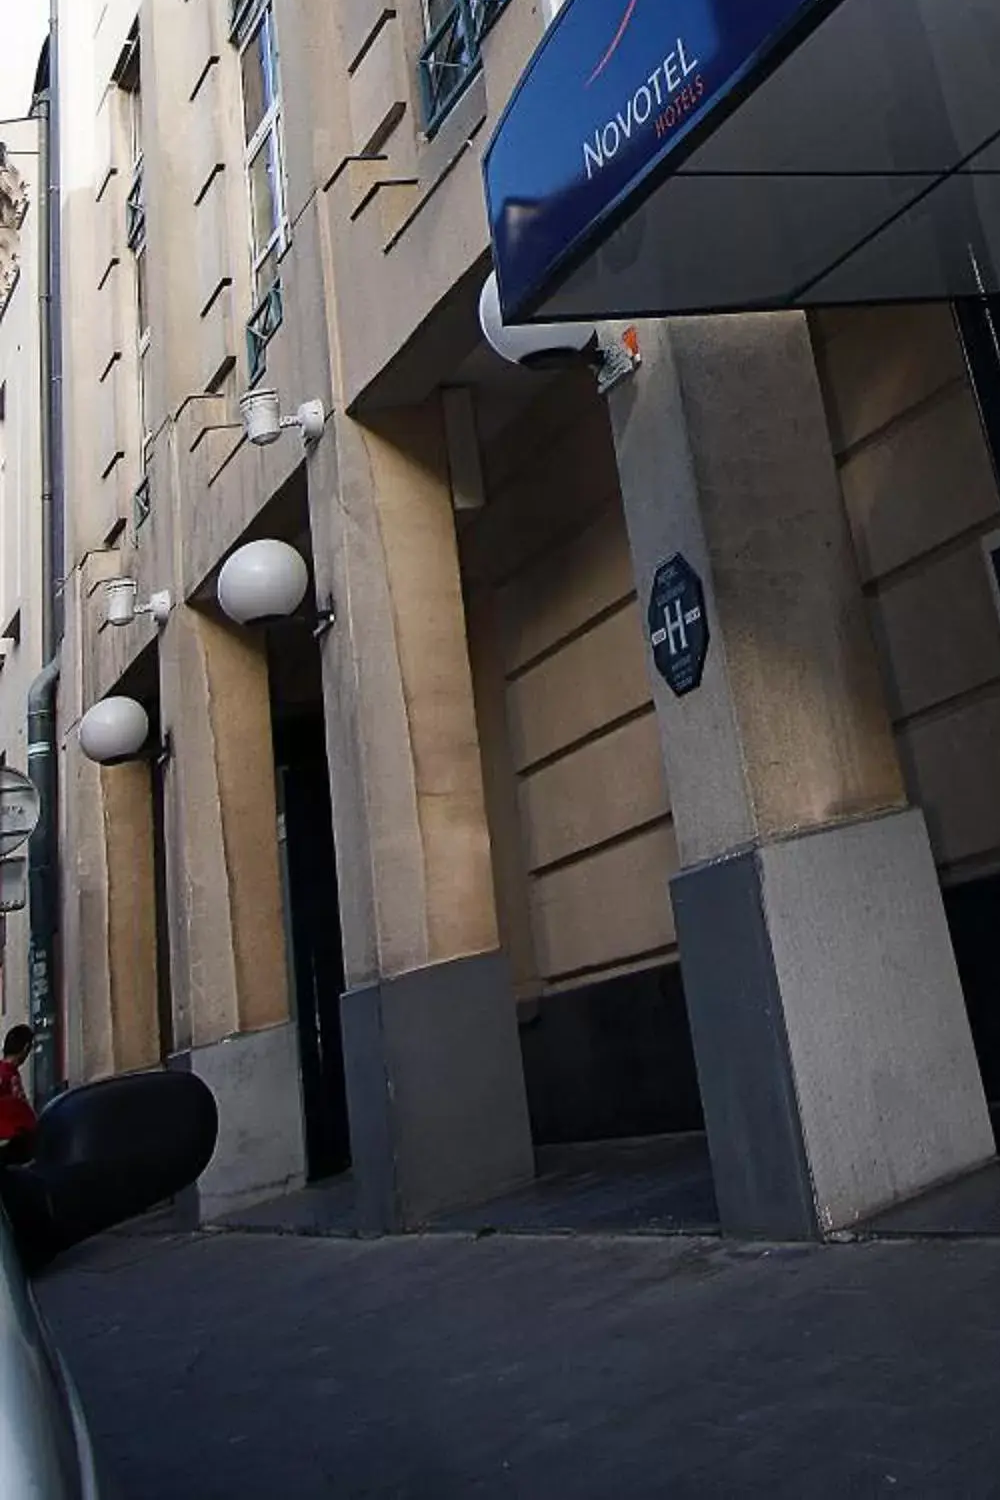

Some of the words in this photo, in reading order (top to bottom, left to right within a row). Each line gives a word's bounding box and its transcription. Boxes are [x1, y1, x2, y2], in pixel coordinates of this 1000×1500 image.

[583, 37, 699, 181] NOVOTEL
[655, 74, 705, 139] HOTELS
[663, 597, 689, 656] H
